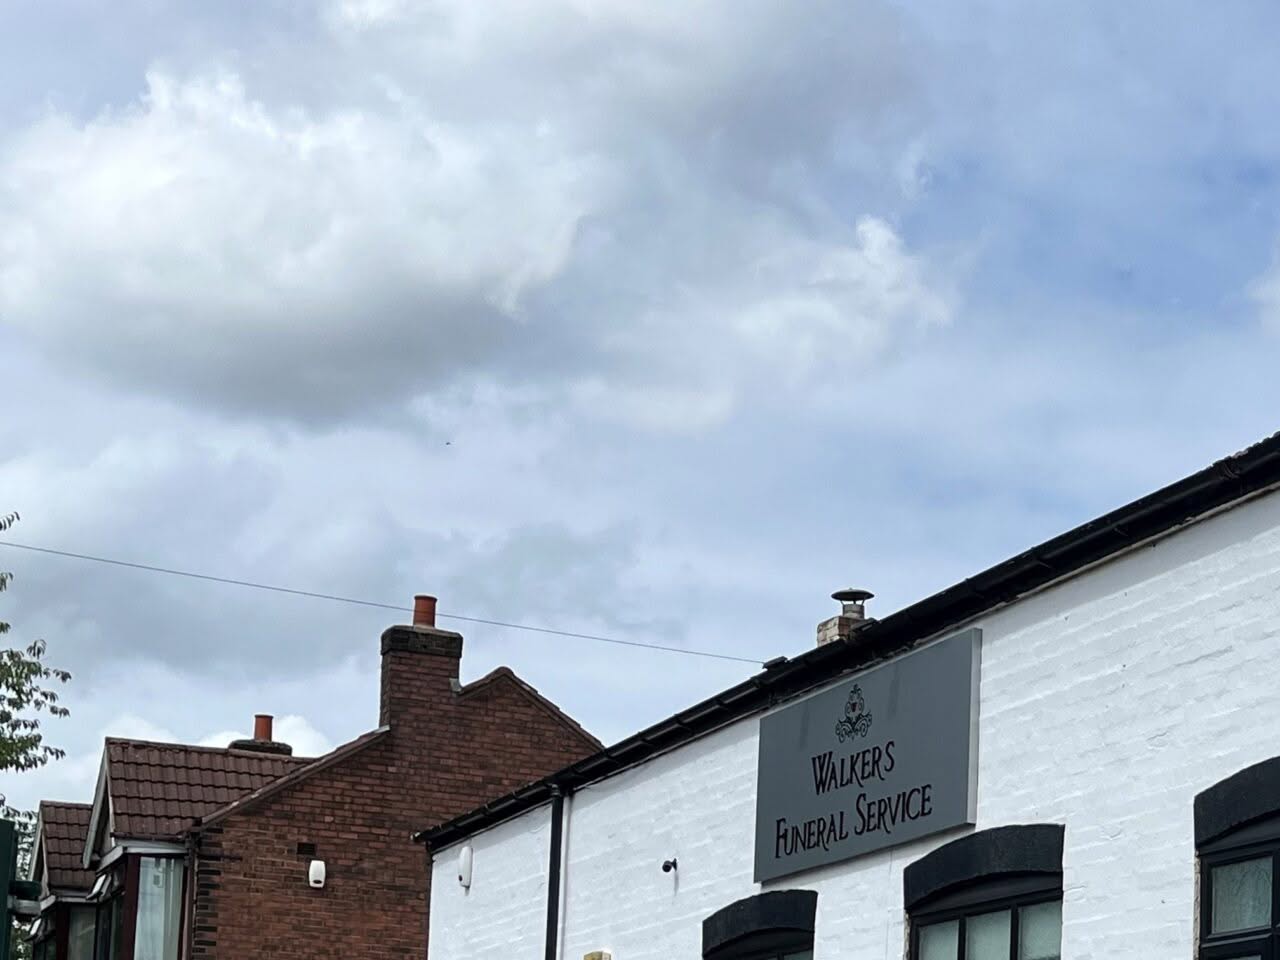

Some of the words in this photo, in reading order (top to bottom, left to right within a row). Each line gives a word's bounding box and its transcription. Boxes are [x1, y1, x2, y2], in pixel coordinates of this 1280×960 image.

[811, 741, 895, 796] WALKERS
[775, 810, 849, 859] FUNERAL
[854, 784, 933, 836] SERVICE
